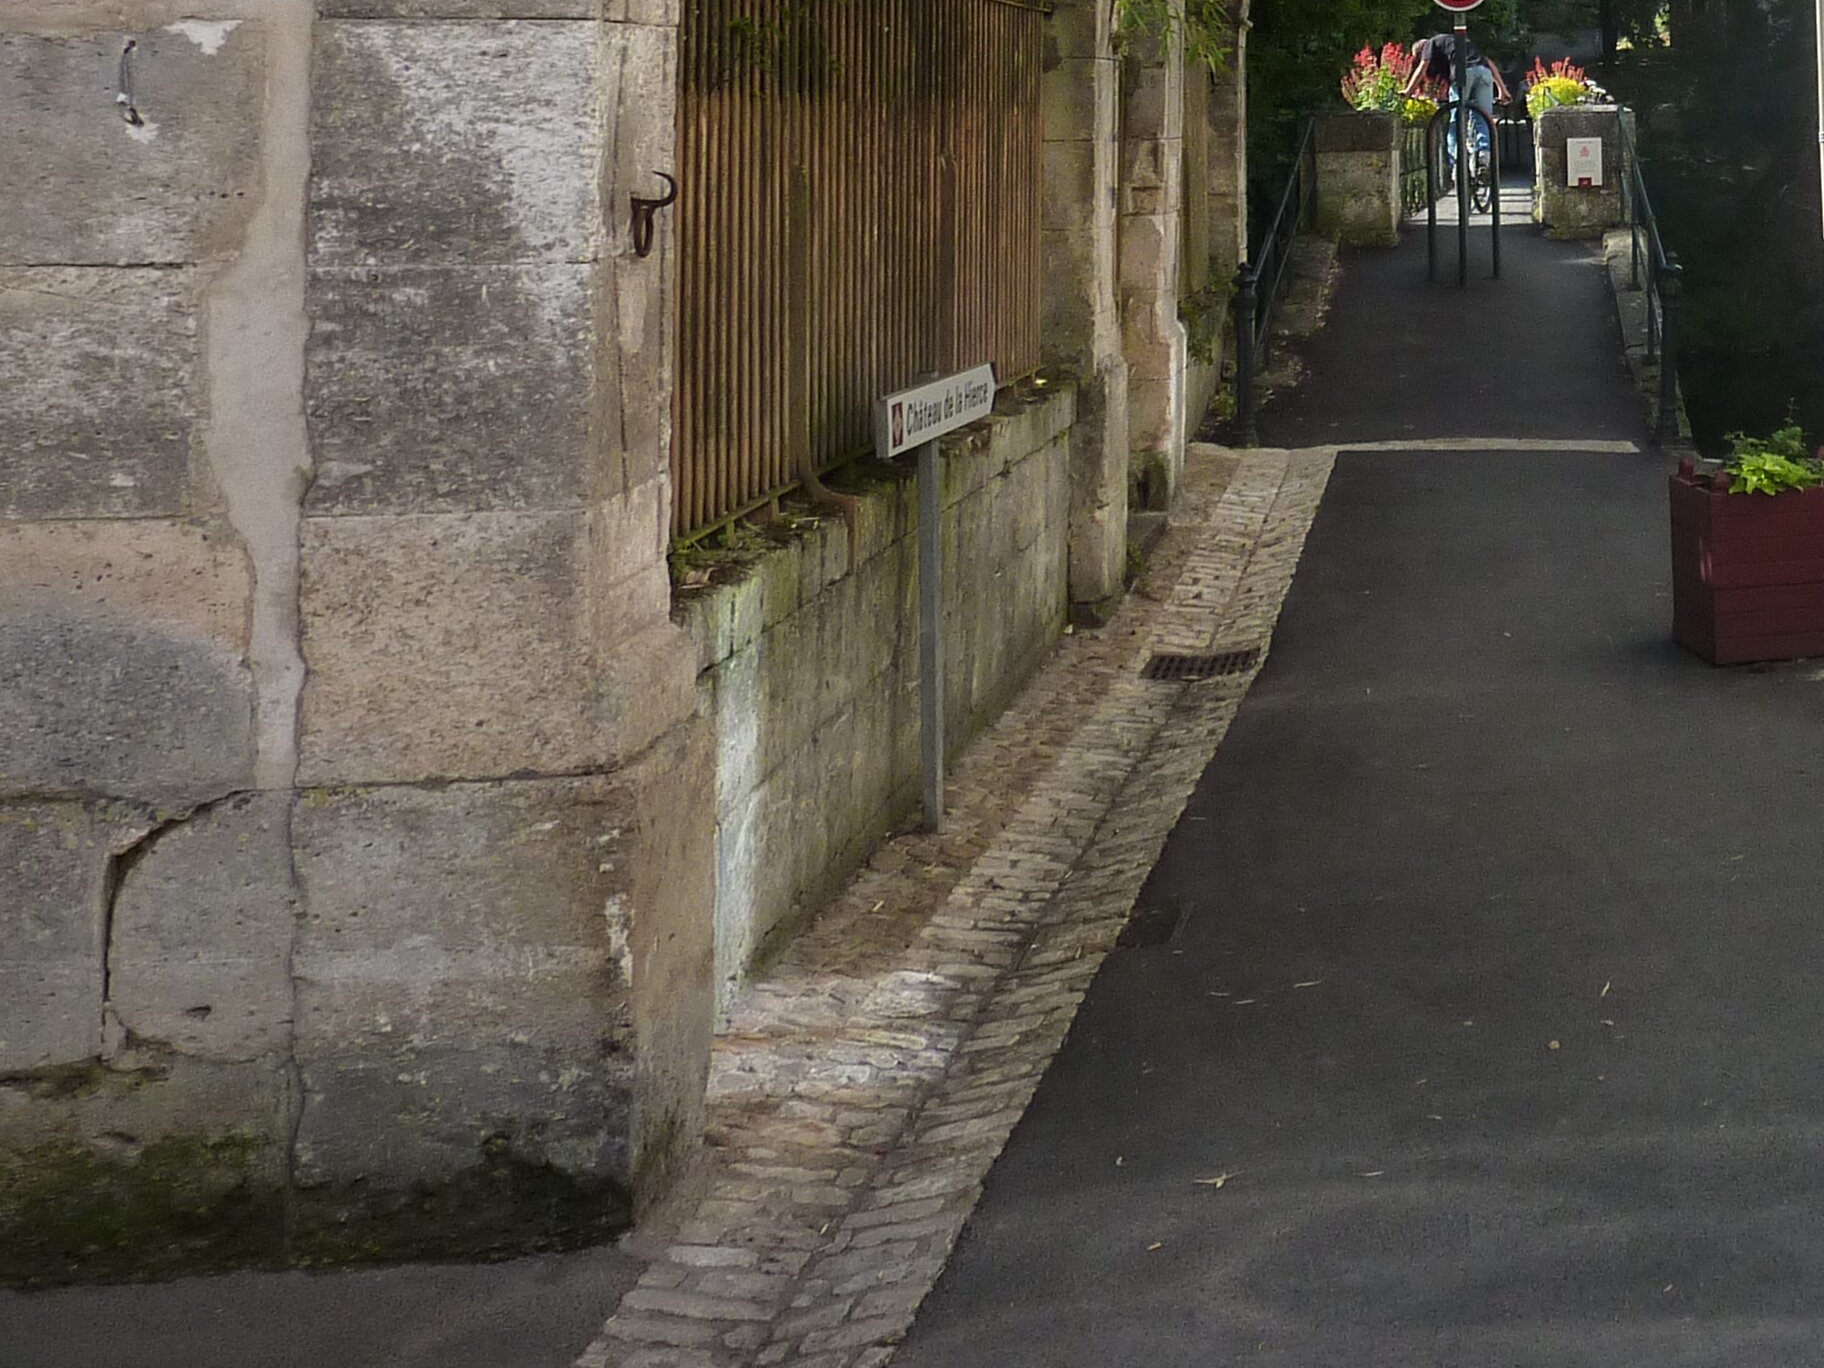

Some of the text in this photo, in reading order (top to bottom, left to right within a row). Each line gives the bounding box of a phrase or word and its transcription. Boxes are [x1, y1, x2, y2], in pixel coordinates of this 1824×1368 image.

[906, 400, 942, 436] Château
[944, 389, 953, 420] de
[956, 385, 963, 414] la
